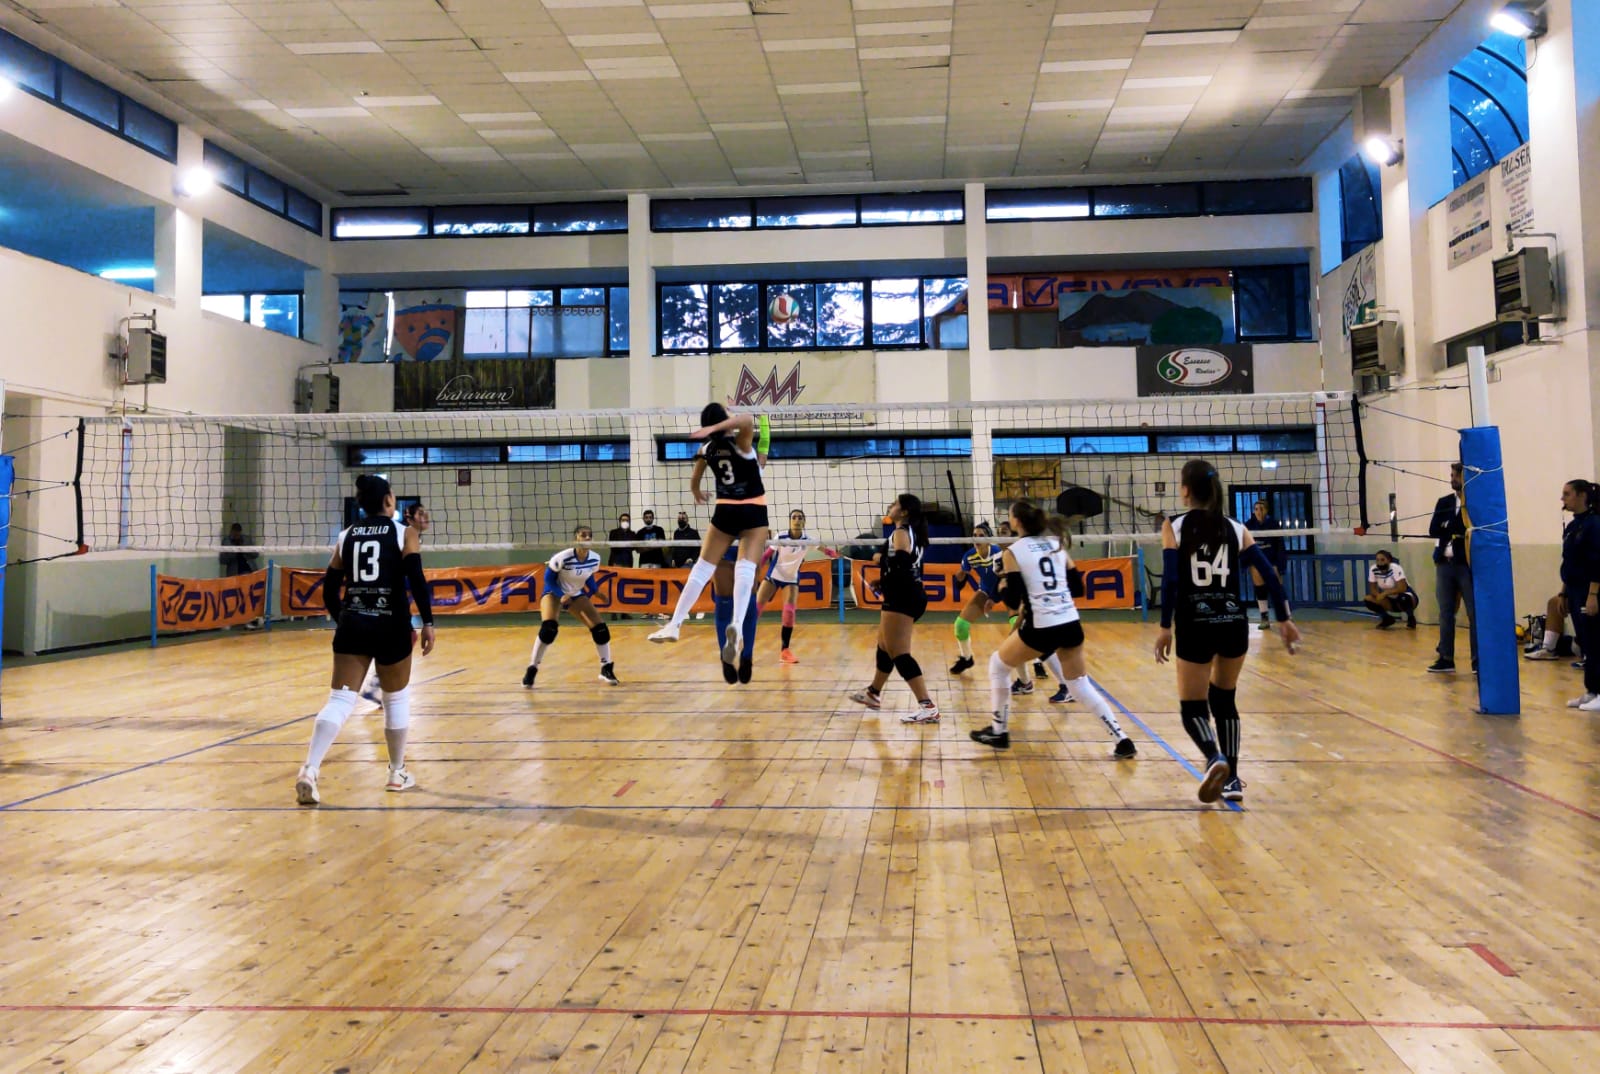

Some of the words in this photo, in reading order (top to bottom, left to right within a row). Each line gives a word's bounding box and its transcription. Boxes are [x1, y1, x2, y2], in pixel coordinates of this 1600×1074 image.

[718, 460, 735, 486] 3
[352, 525, 390, 536] SALZILLO
[353, 540, 381, 583] 13
[1038, 556, 1058, 591] 9
[1190, 543, 1230, 588] 64
